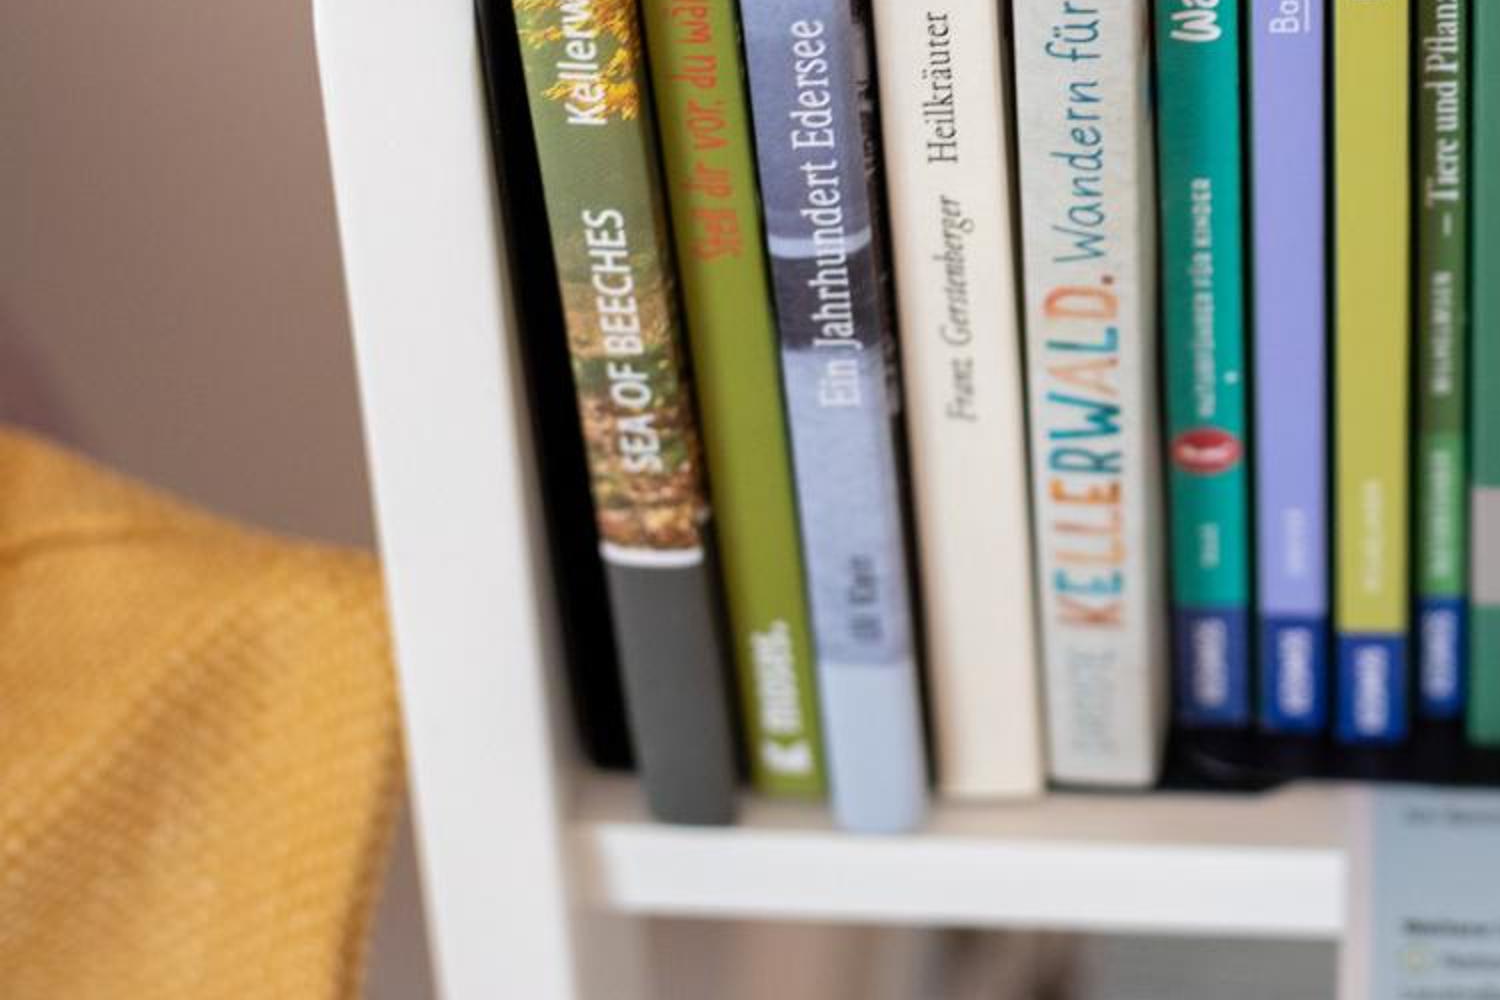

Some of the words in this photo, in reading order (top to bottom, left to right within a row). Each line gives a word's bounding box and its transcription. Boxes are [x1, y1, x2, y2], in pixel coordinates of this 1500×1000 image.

[1045, 1, 1100, 62] für
[672, 54, 717, 90] du
[791, 19, 836, 149] Edersee
[922, 11, 958, 164] Heilkräuter
[1425, 81, 1459, 134] und
[1050, 81, 1106, 263] Wandern
[1425, 139, 1460, 207] Tiere
[581, 208, 642, 355] BEECHES
[801, 160, 863, 350] Jahrhundert
[934, 194, 975, 348] Gerstenberger
[608, 362, 653, 409] OF
[818, 358, 862, 409] Ein
[946, 358, 978, 424] Franz
[619, 416, 662, 472] SEA
[1043, 274, 1126, 630] KELLERWALD.
